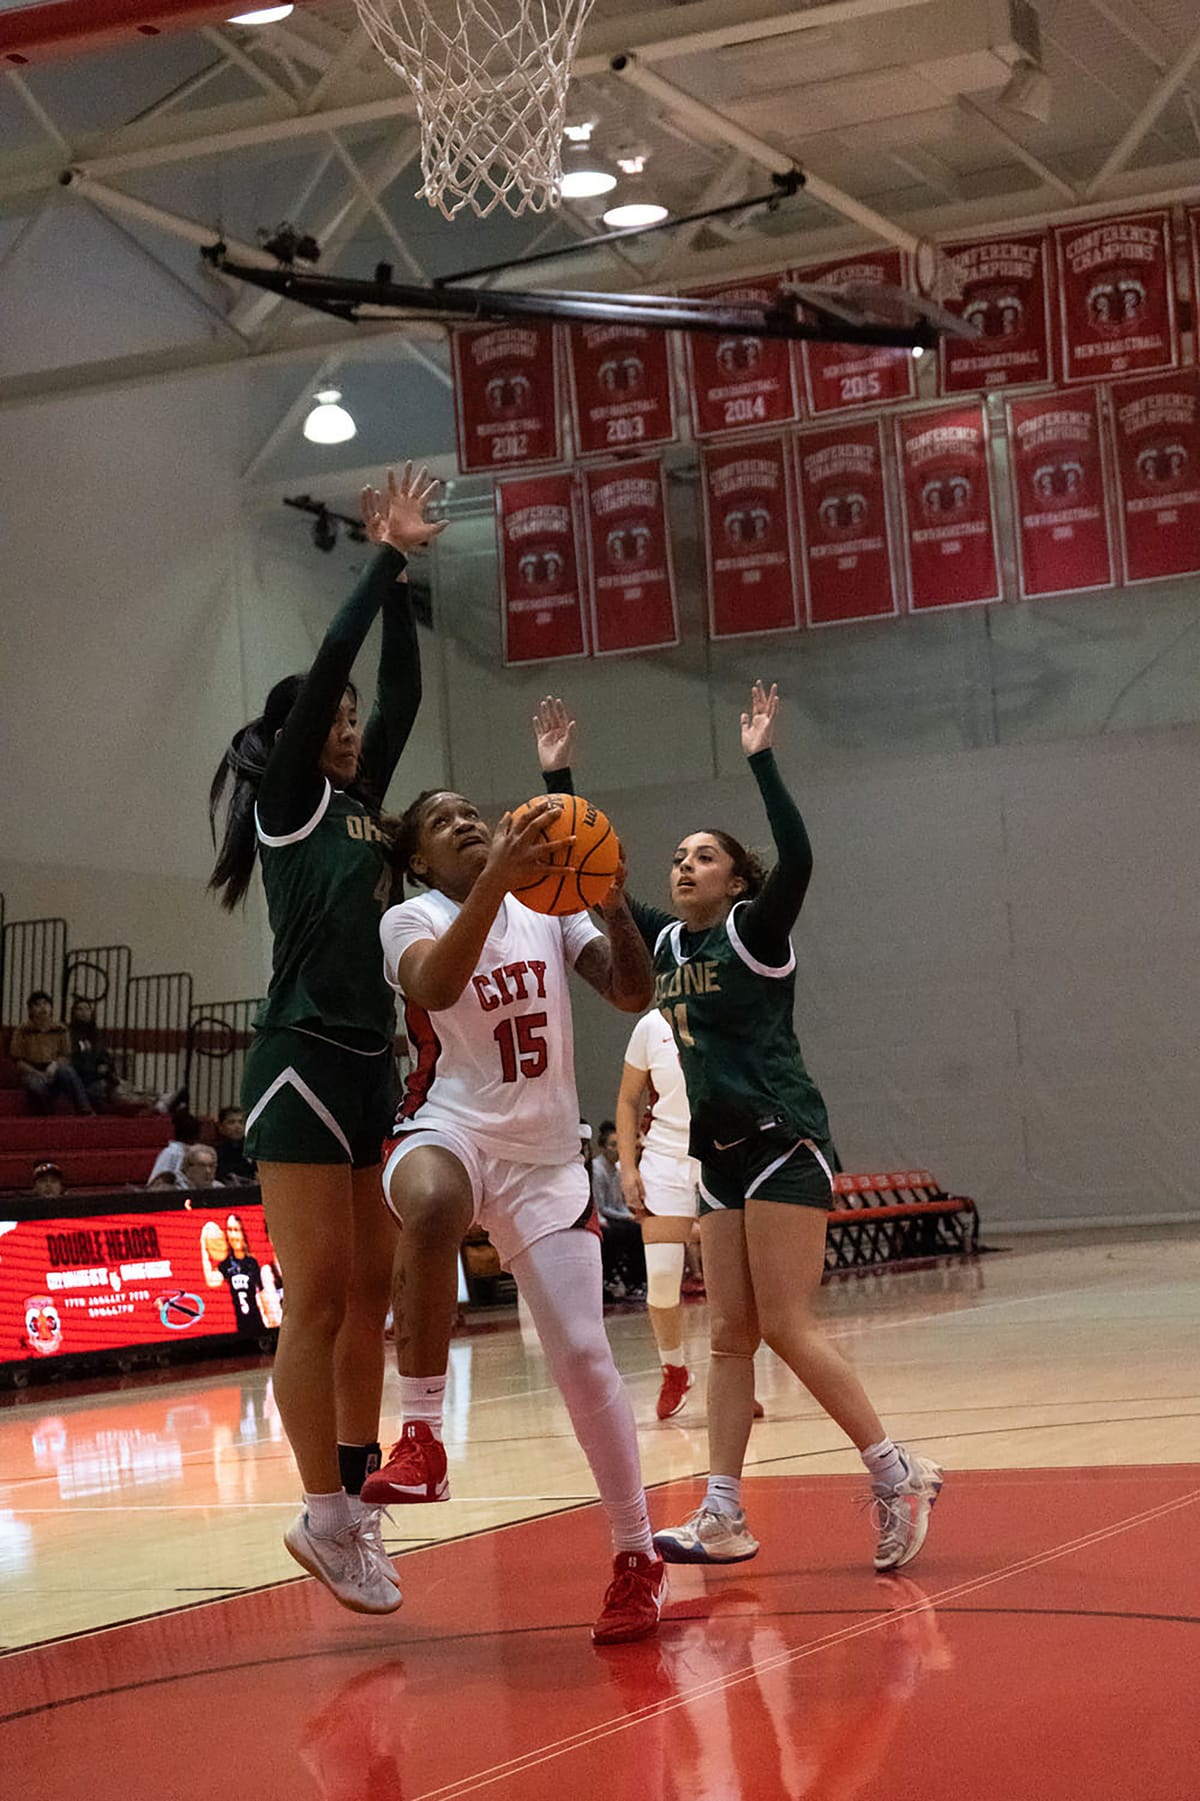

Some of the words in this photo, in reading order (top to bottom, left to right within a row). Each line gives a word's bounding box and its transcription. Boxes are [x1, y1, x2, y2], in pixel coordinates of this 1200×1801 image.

[1066, 224, 1160, 259] CONFERENCE
[1073, 241, 1155, 274] CHAMPIONS
[840, 372, 880, 399] 2015
[725, 395, 765, 422] 2014
[1119, 394, 1197, 420] CONFERENCE
[606, 416, 645, 441] 2013
[1017, 411, 1091, 437] CONFERENCE
[492, 434, 528, 459] 2012
[472, 960, 547, 1012] CITY
[493, 1011, 548, 1083] 15
[46, 1230, 105, 1267] DOUBLE
[104, 1226, 161, 1262] HEADER
